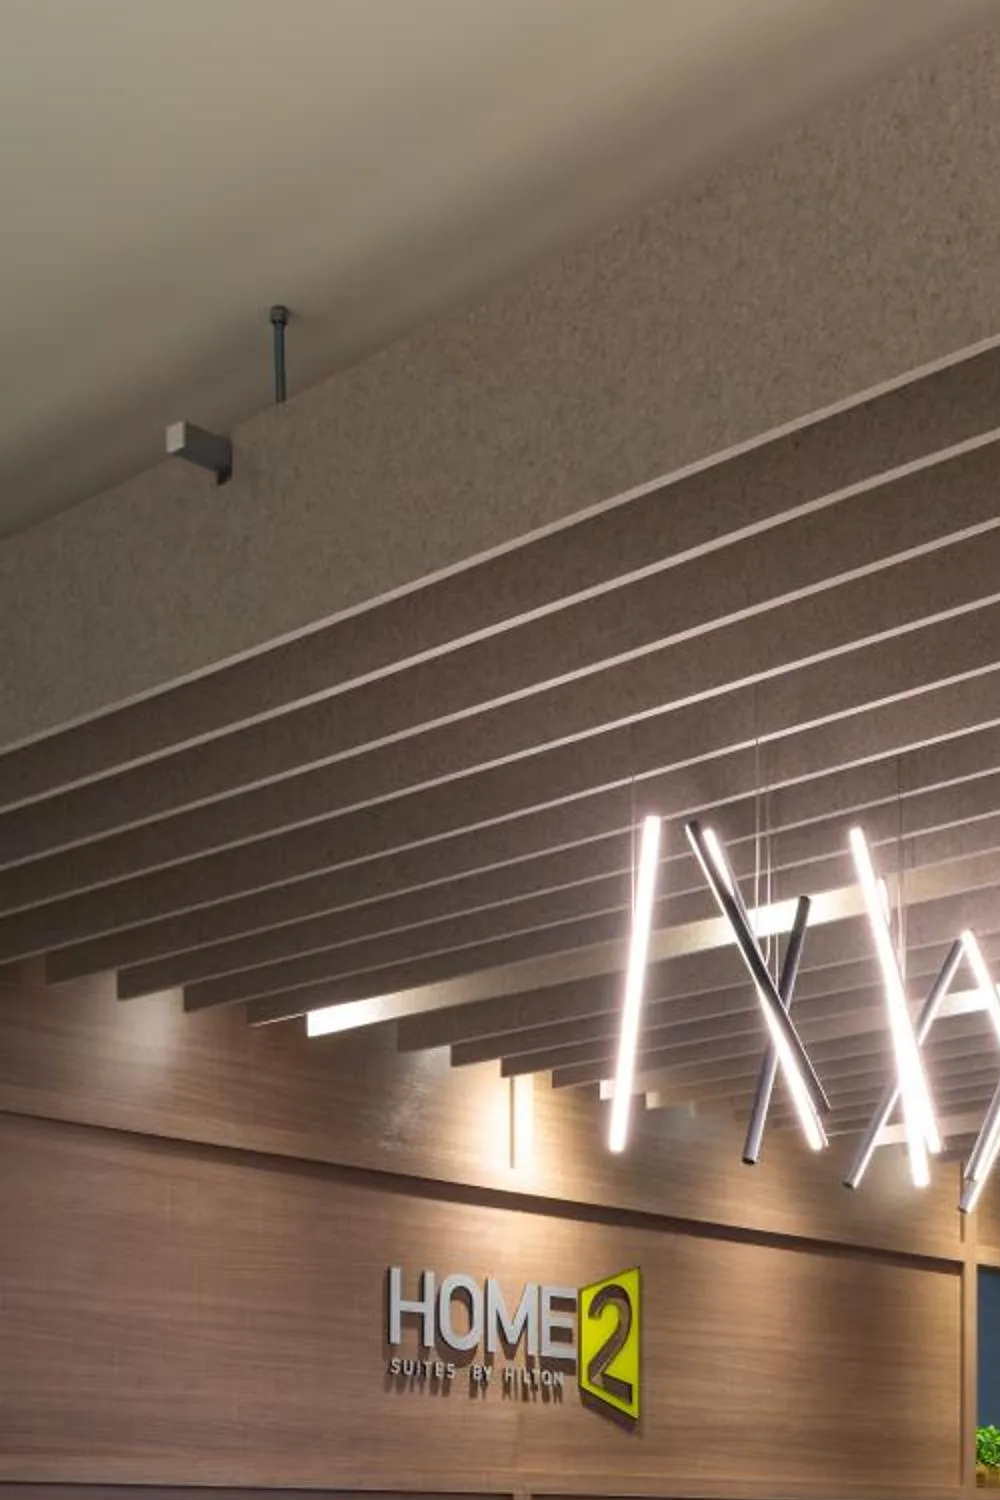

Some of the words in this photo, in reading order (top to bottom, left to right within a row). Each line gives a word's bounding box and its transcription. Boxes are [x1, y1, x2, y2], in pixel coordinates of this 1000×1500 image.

[389, 1358, 456, 1379] SUITES
[472, 1364, 493, 1382] BY
[504, 1367, 565, 1387] HILTON
